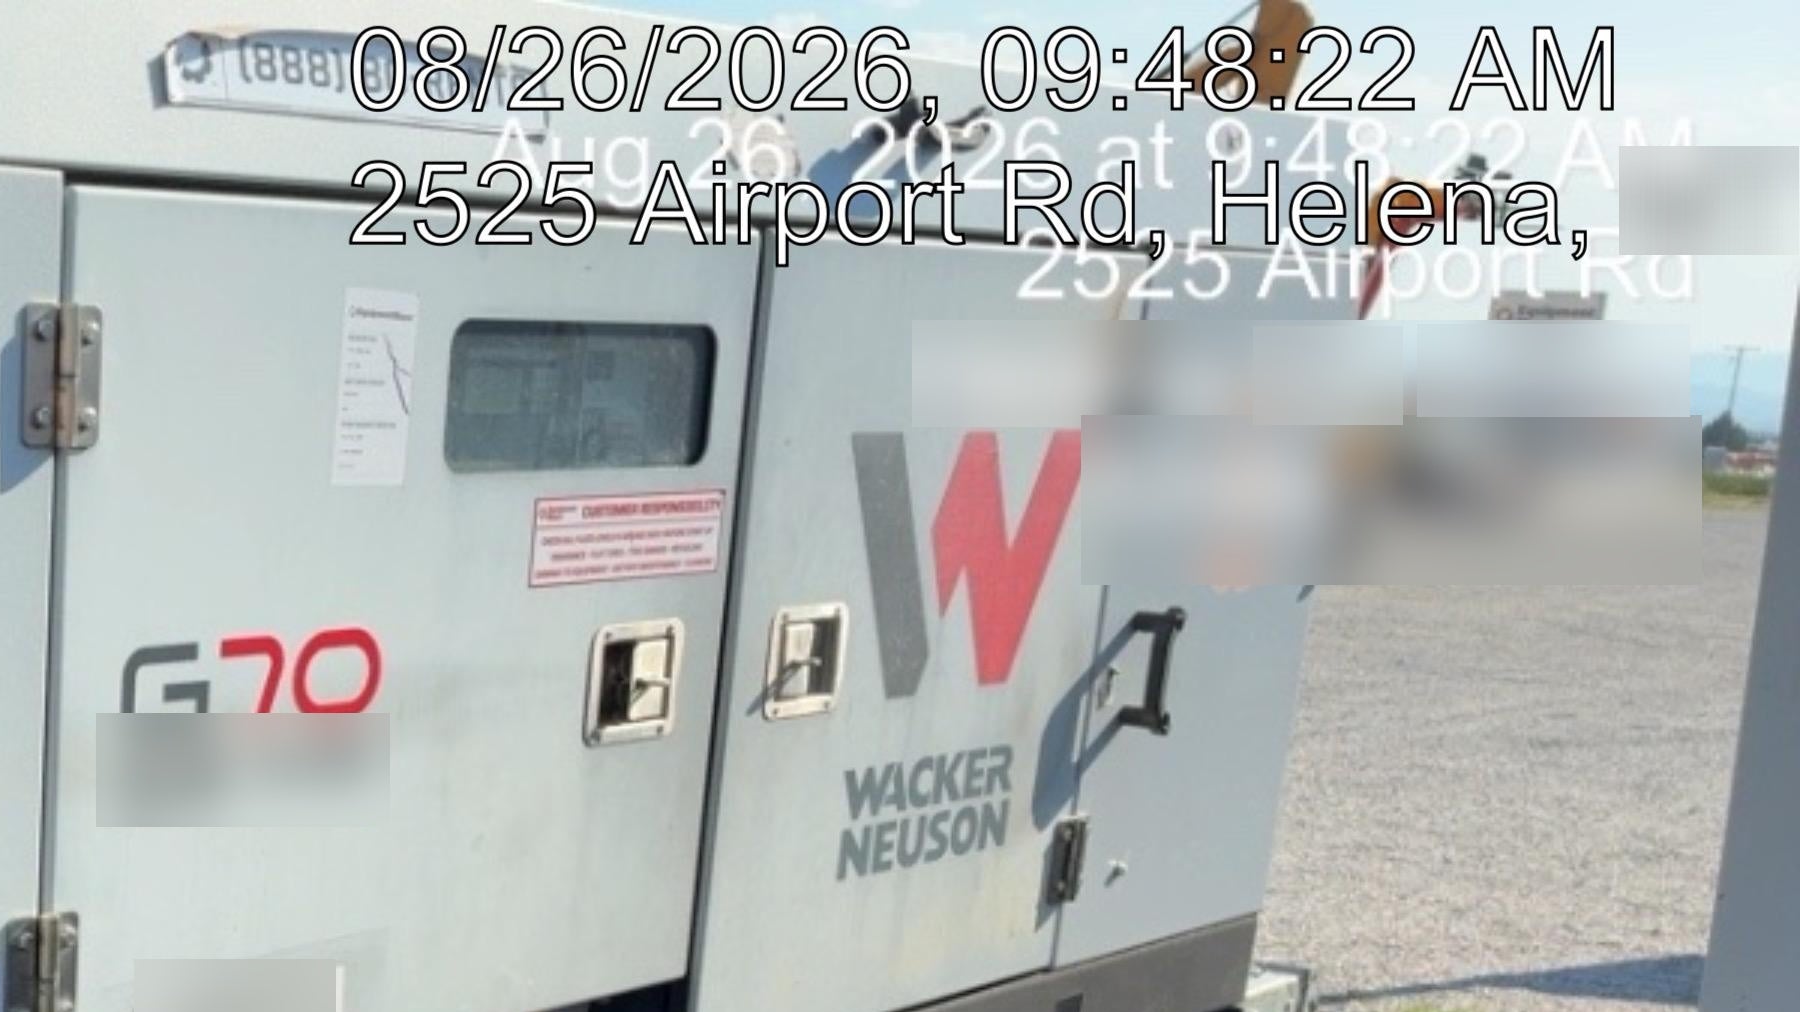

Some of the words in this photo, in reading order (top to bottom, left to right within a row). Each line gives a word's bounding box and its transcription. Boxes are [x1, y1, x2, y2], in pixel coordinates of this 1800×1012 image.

[238, 41, 347, 94] (888)
[120, 627, 382, 713] G70
[843, 744, 1015, 821] WACKER
[835, 798, 1012, 882] NEUSON
